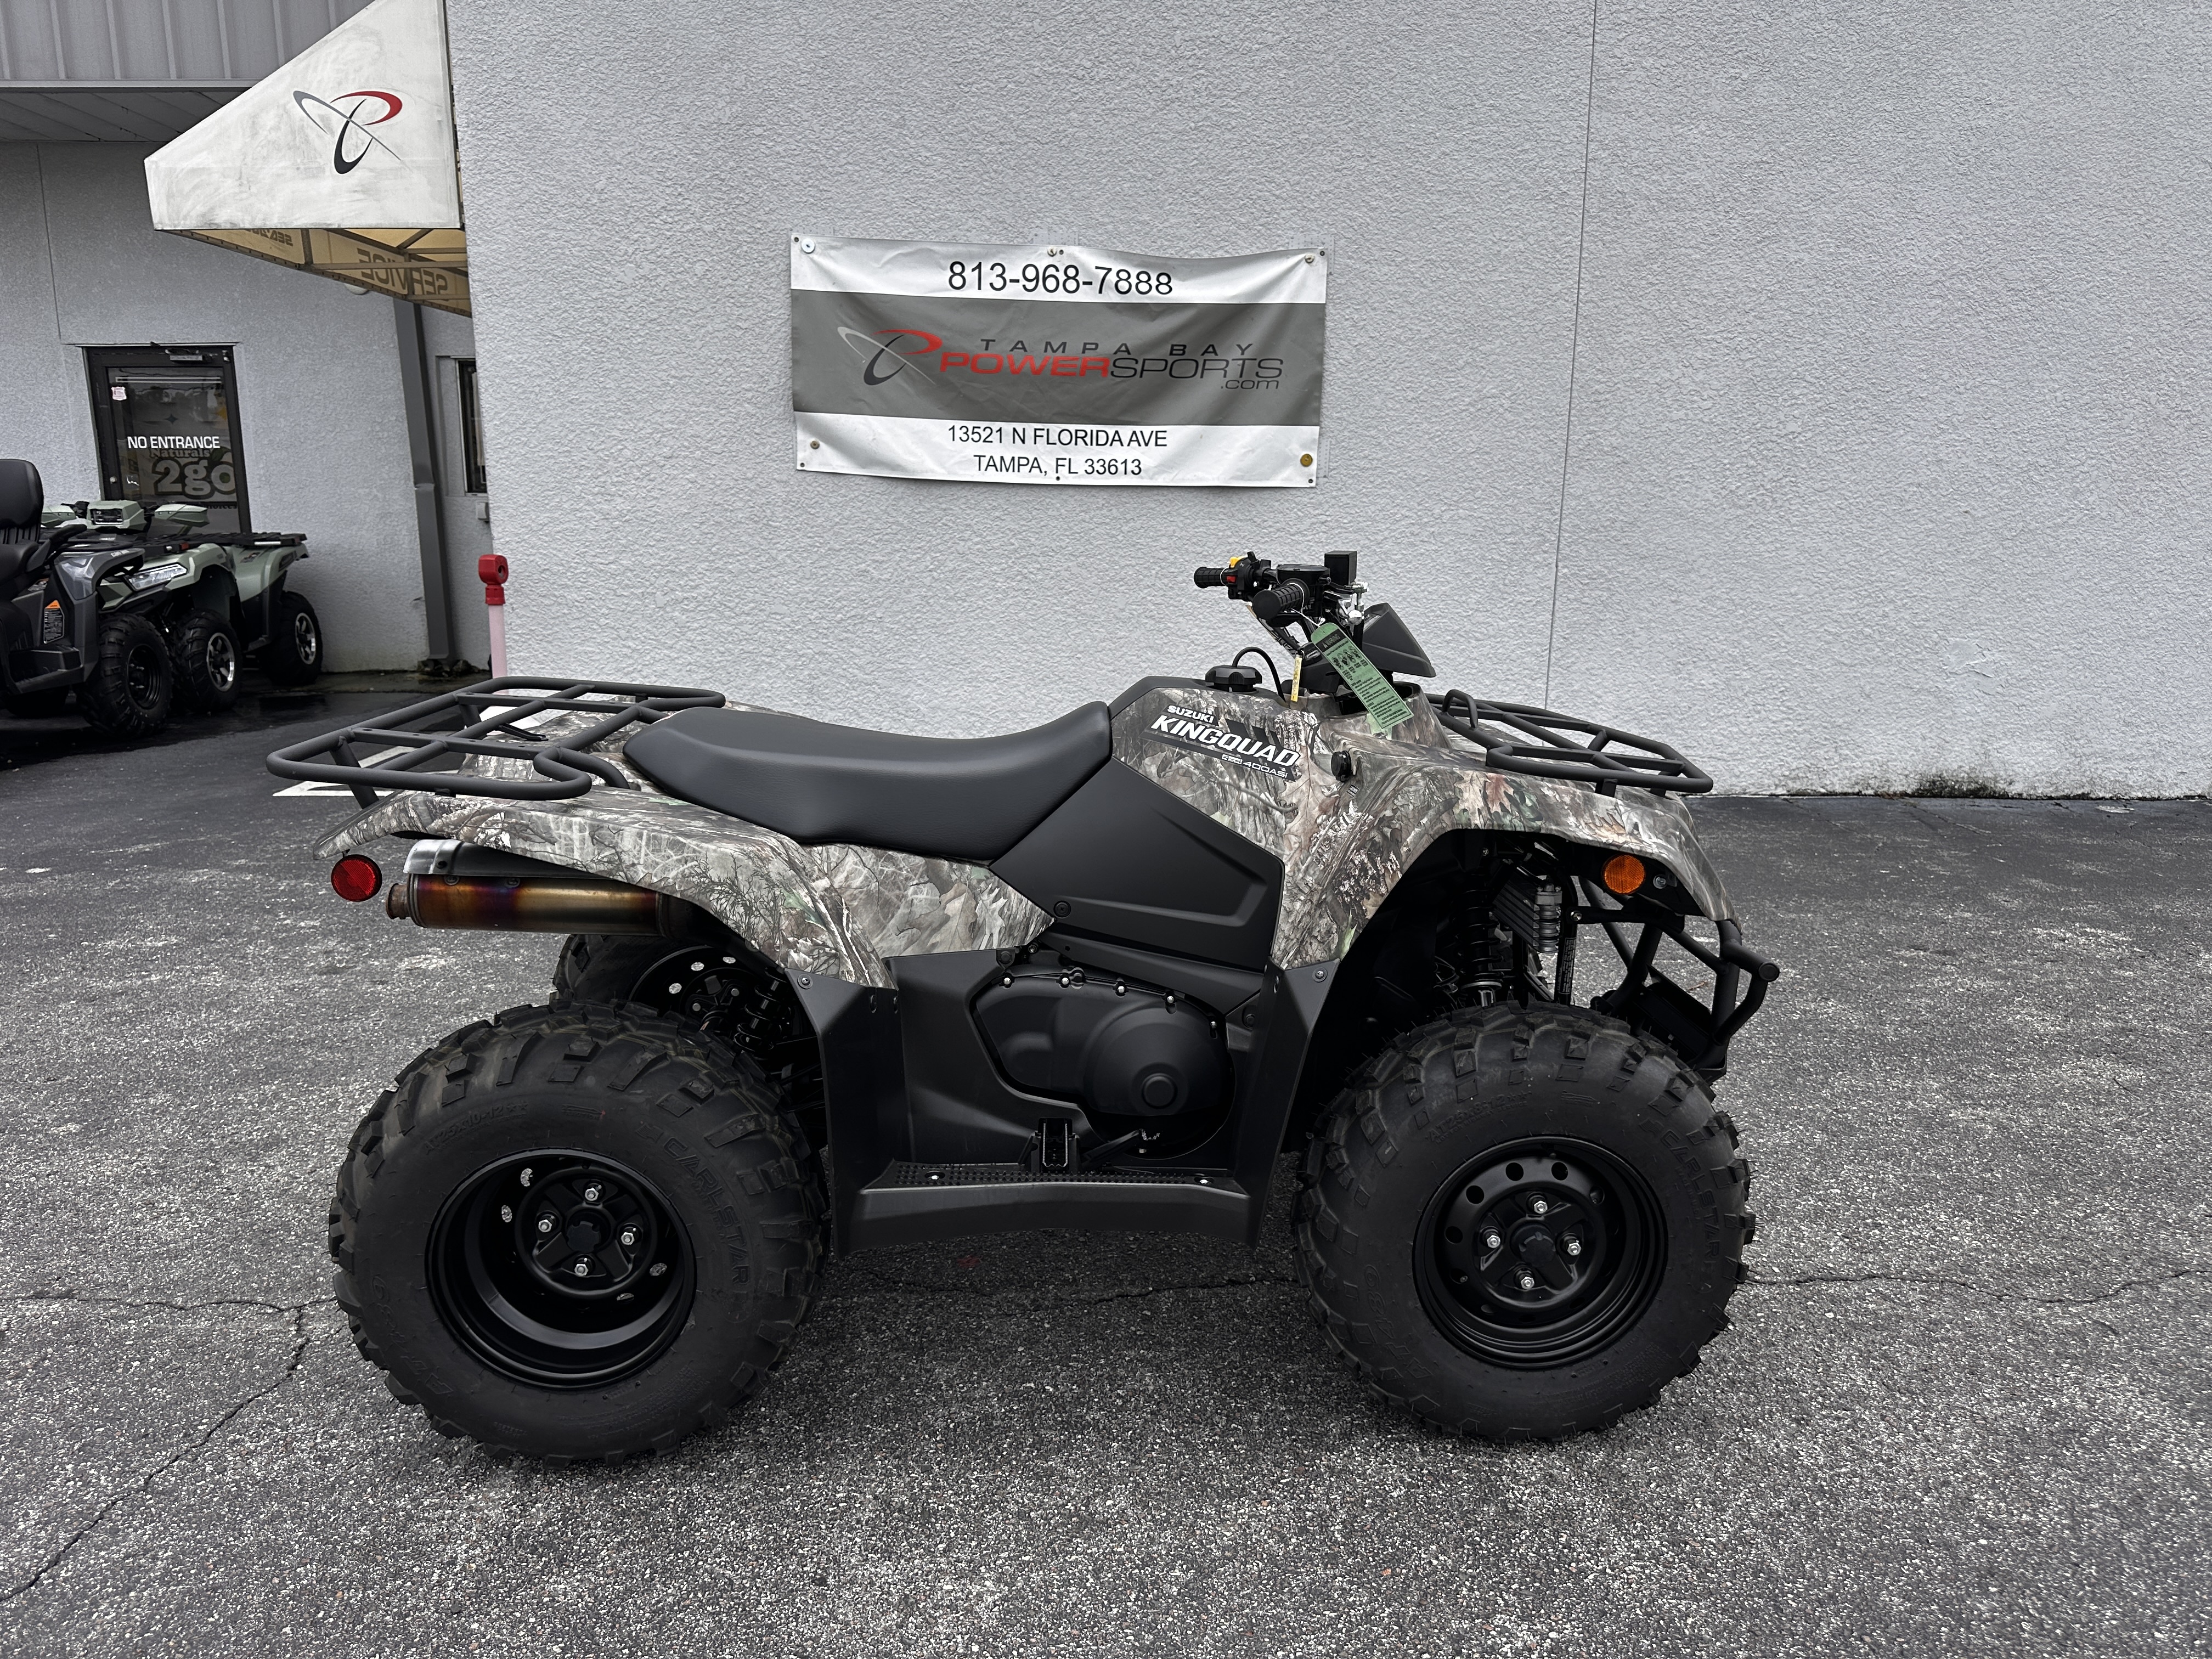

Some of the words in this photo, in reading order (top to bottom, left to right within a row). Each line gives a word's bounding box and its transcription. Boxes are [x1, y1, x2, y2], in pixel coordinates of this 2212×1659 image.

[948, 261, 1173, 295] 813-968-7888
[980, 338, 1131, 354] TAMPA
[1169, 343, 1253, 356] BAY
[940, 352, 1284, 379] POWERSPORTS
[1221, 380, 1279, 390] .com
[127, 436, 147, 449] NO
[150, 436, 221, 449] ENTRANCE
[948, 425, 1003, 443] 13521
[1013, 427, 1026, 444] N
[1034, 428, 1124, 447] FLORIDA
[1127, 430, 1167, 447] AVE
[150, 449, 211, 458] Naturals
[974, 455, 1047, 476] TAMPA,
[1056, 458, 1078, 474] FL
[1085, 459, 1142, 476] 33613
[153, 459, 236, 498] 2go
[1167, 705, 1214, 723] SUZUKI
[1151, 715, 1301, 766] KINGQUAD
[1660, 1129, 1720, 1261] CARLSTAR
[663, 1136, 751, 1286] CARLSTAR
